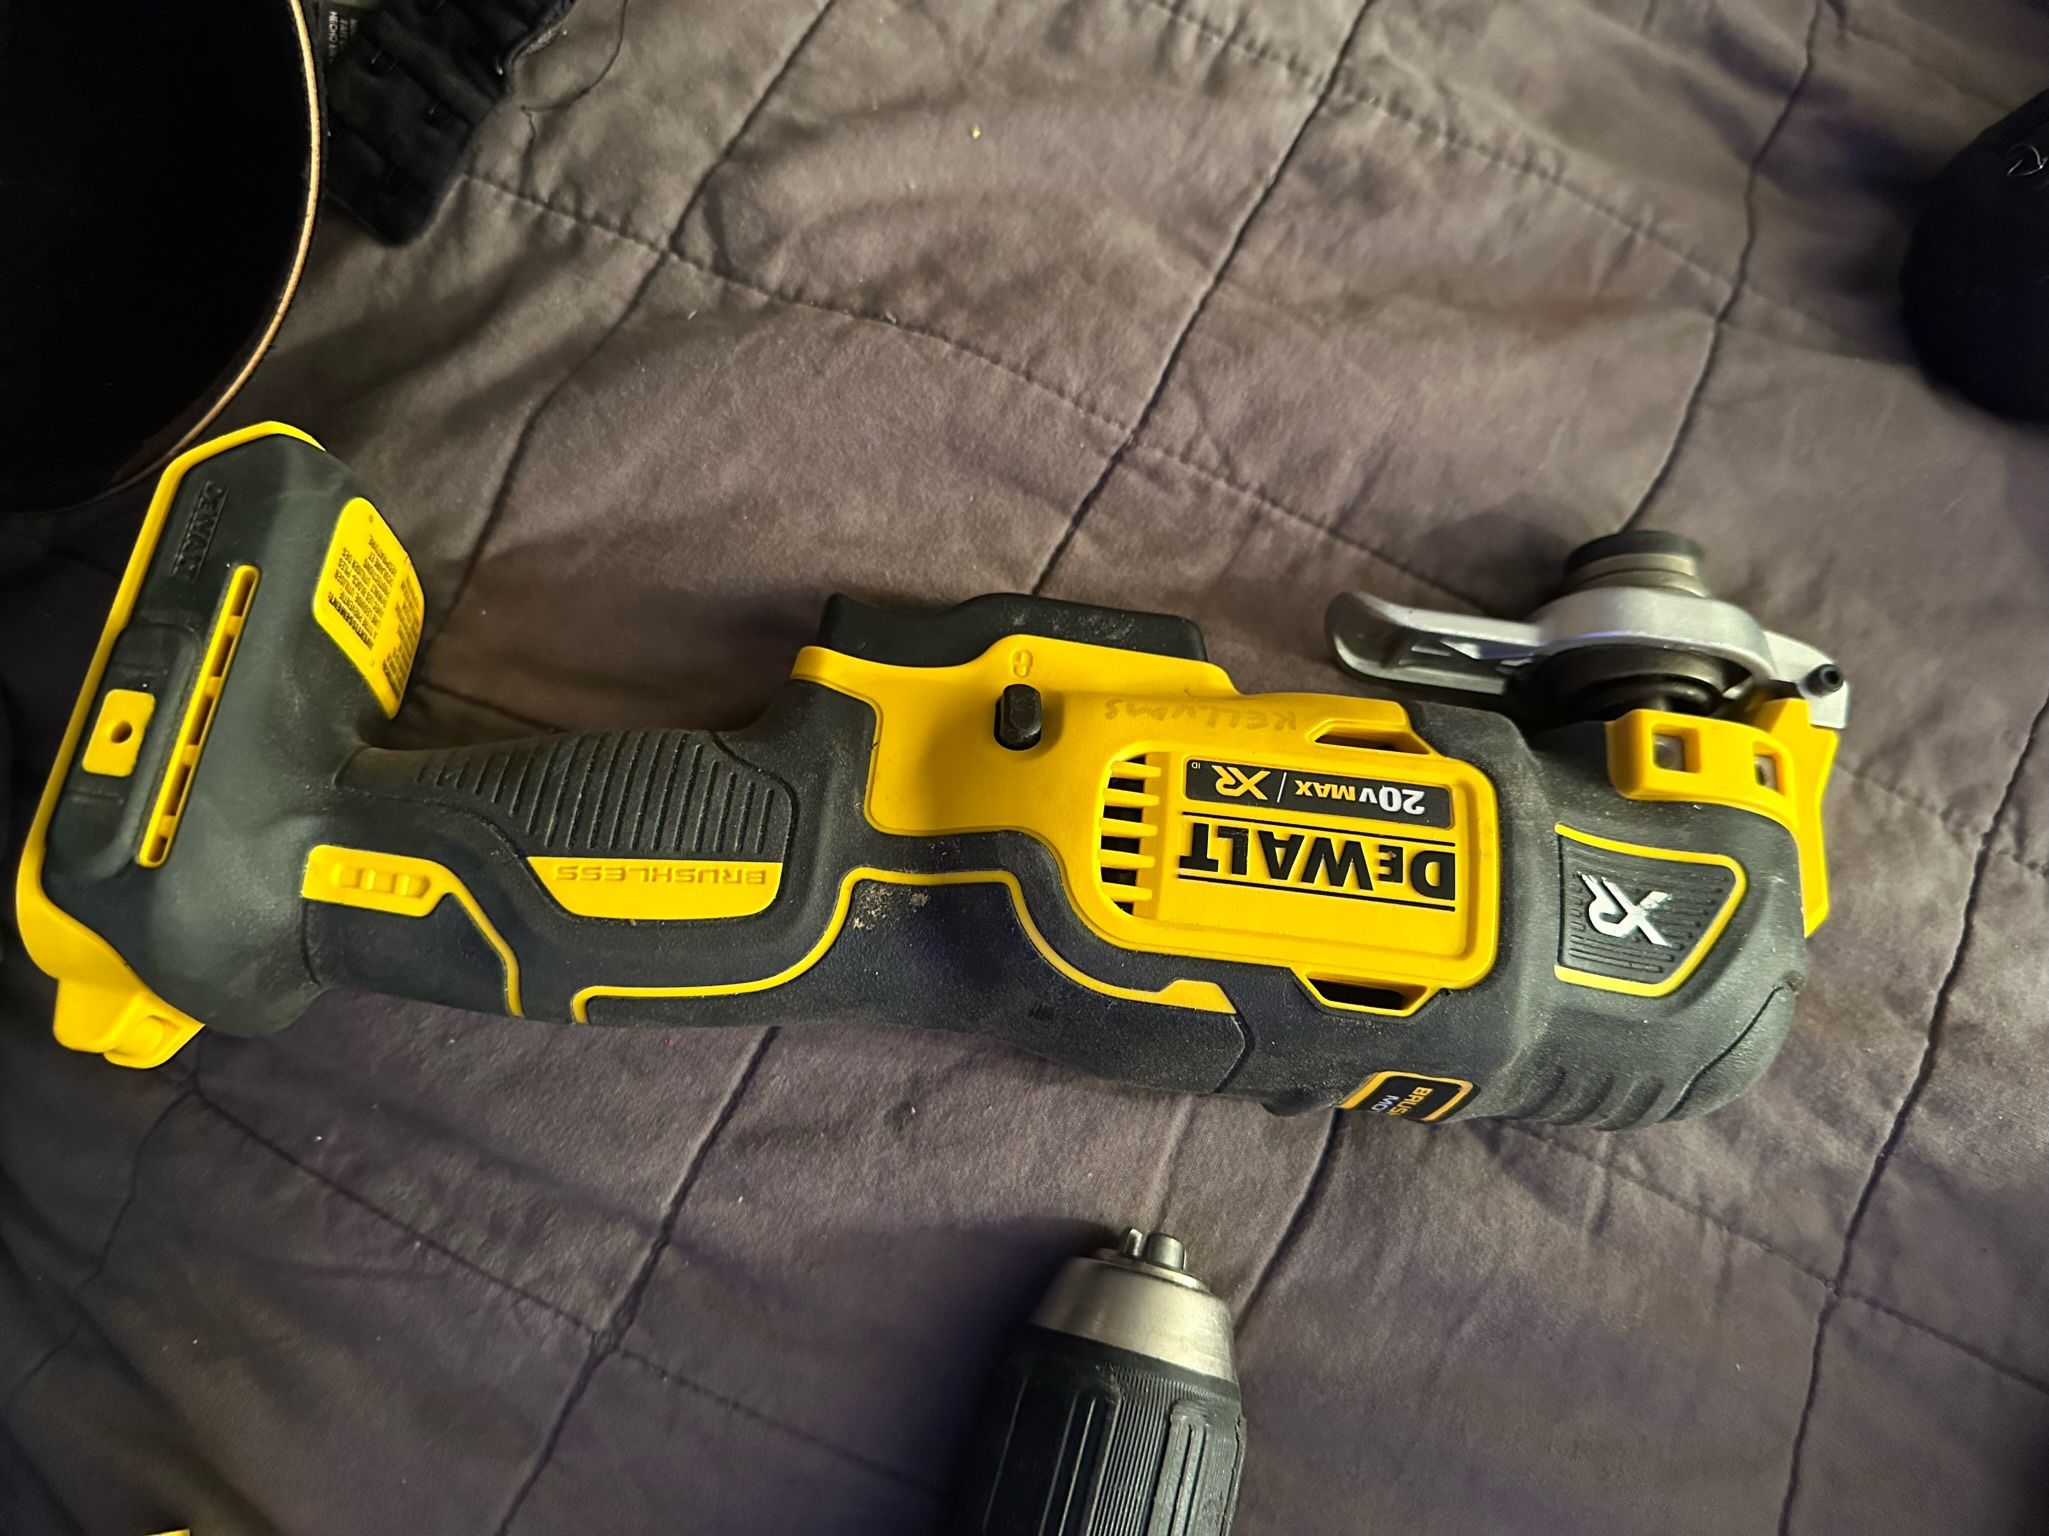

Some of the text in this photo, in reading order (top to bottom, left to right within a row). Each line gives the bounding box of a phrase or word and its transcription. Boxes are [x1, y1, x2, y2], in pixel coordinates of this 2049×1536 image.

[1211, 764, 1271, 801] XR
[1294, 779, 1357, 801] MAX
[556, 865, 766, 885] BRUSHLESS
[1576, 870, 1673, 948] XR
[1368, 1094, 1400, 1113] MO
[1386, 1086, 1433, 1116] BRUS
